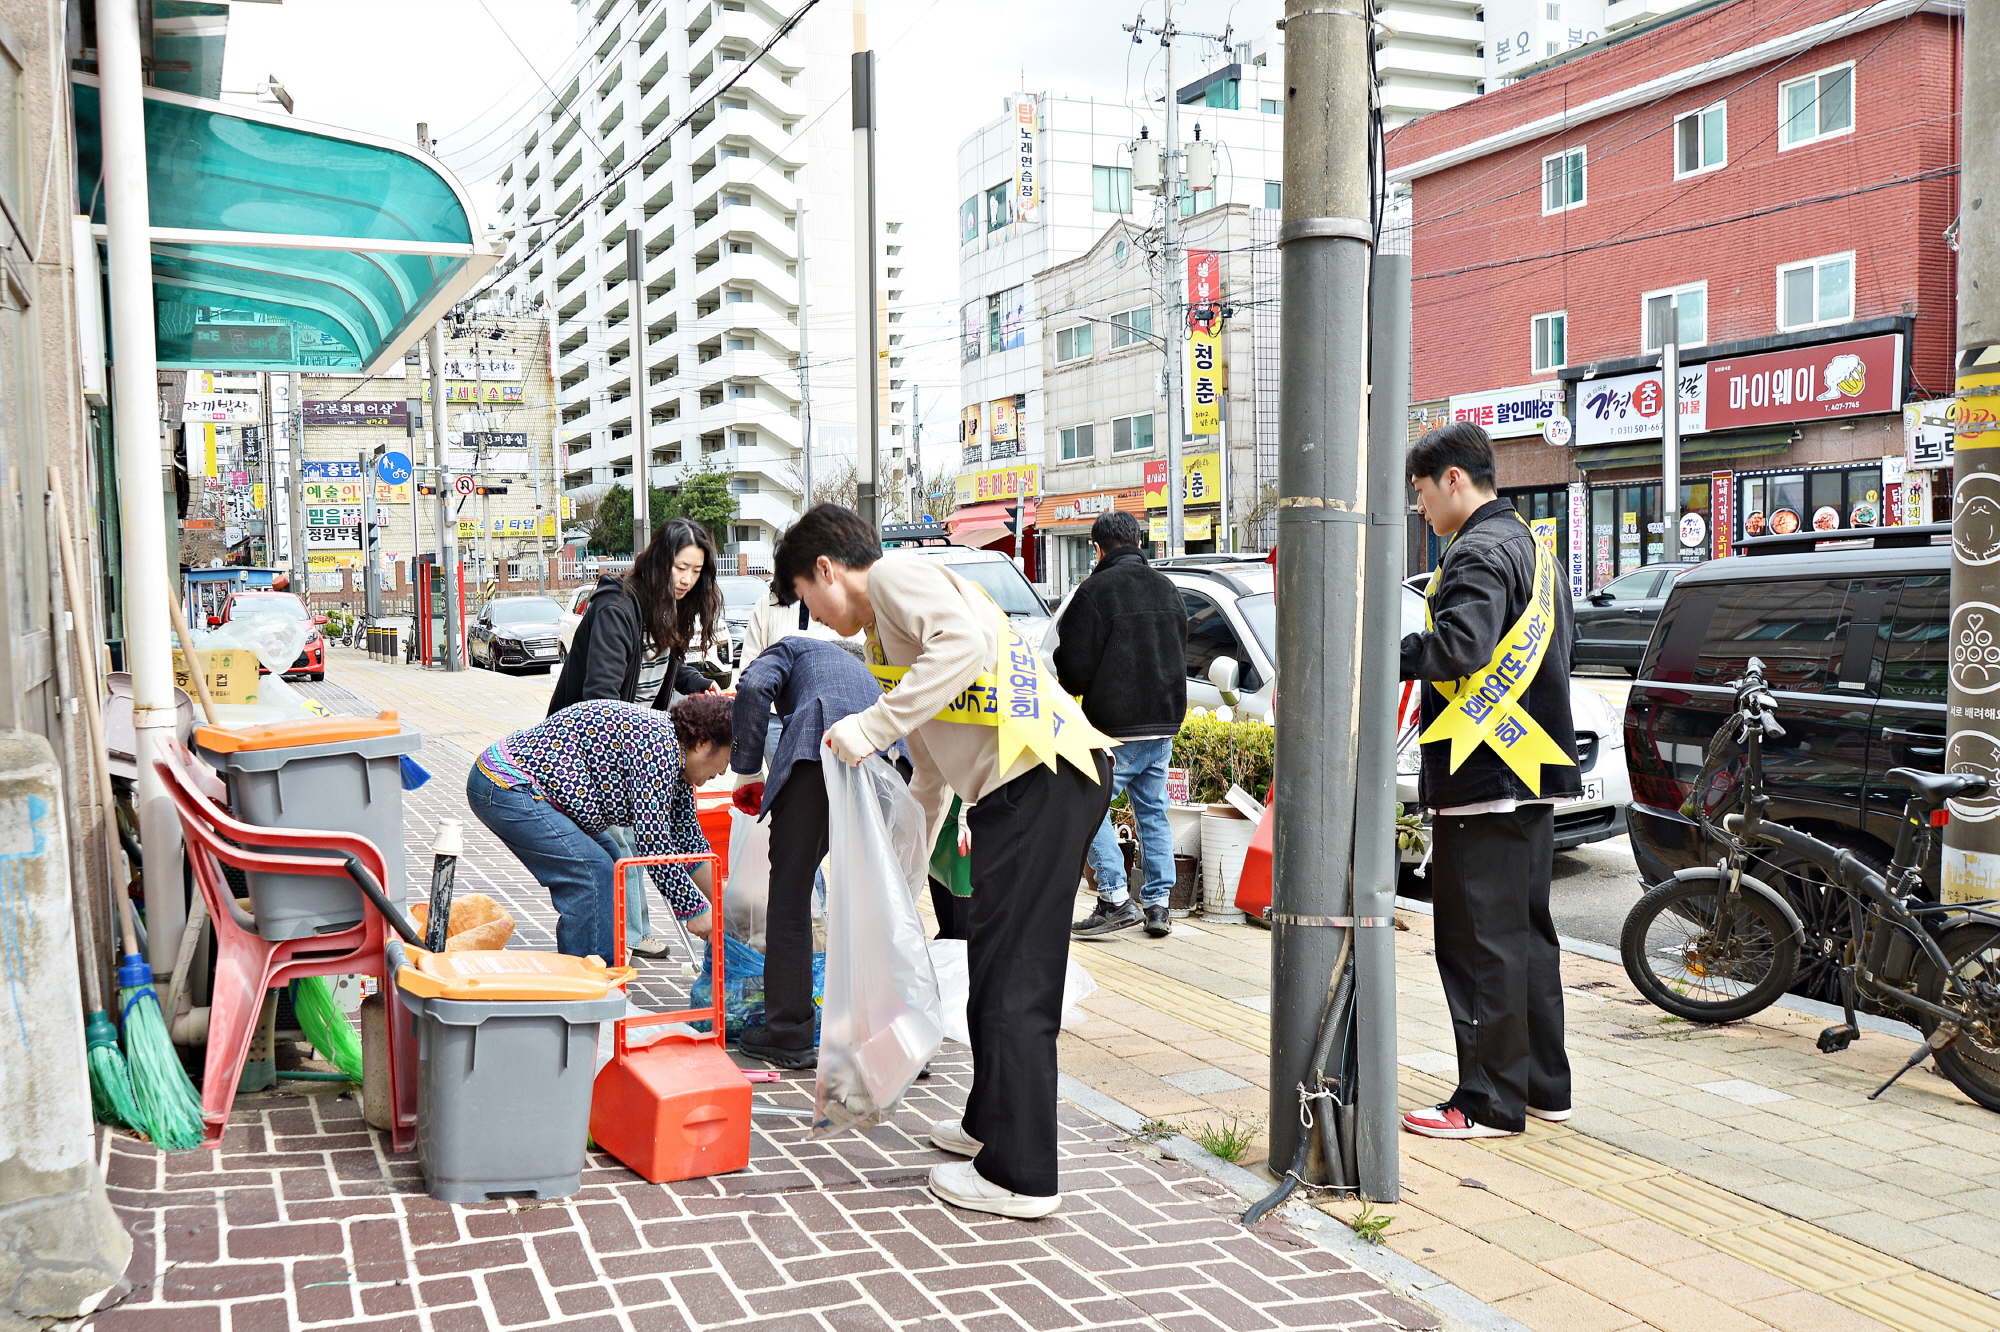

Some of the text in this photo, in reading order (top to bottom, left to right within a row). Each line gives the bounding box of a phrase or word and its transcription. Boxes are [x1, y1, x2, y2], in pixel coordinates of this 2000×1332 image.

[1496, 31, 1531, 65] 본오
[1018, 103, 1034, 124] 탑
[1020, 127, 1033, 197] 노래연습장
[1195, 343, 1214, 404] 청춘
[1729, 365, 1815, 410] 마이웨이
[1497, 399, 1554, 424] 할인매장
[1586, 389, 1632, 420] 강경
[1641, 383, 1659, 414] 참
[1831, 401, 1860, 411] 407-7745
[308, 509, 341, 525] 믿음
[509, 519, 535, 530] 타일
[1598, 536, 1609, 575] 새우젓
[1573, 553, 1582, 598] 전문매장
[1459, 614, 1547, 725] 상가번영회
